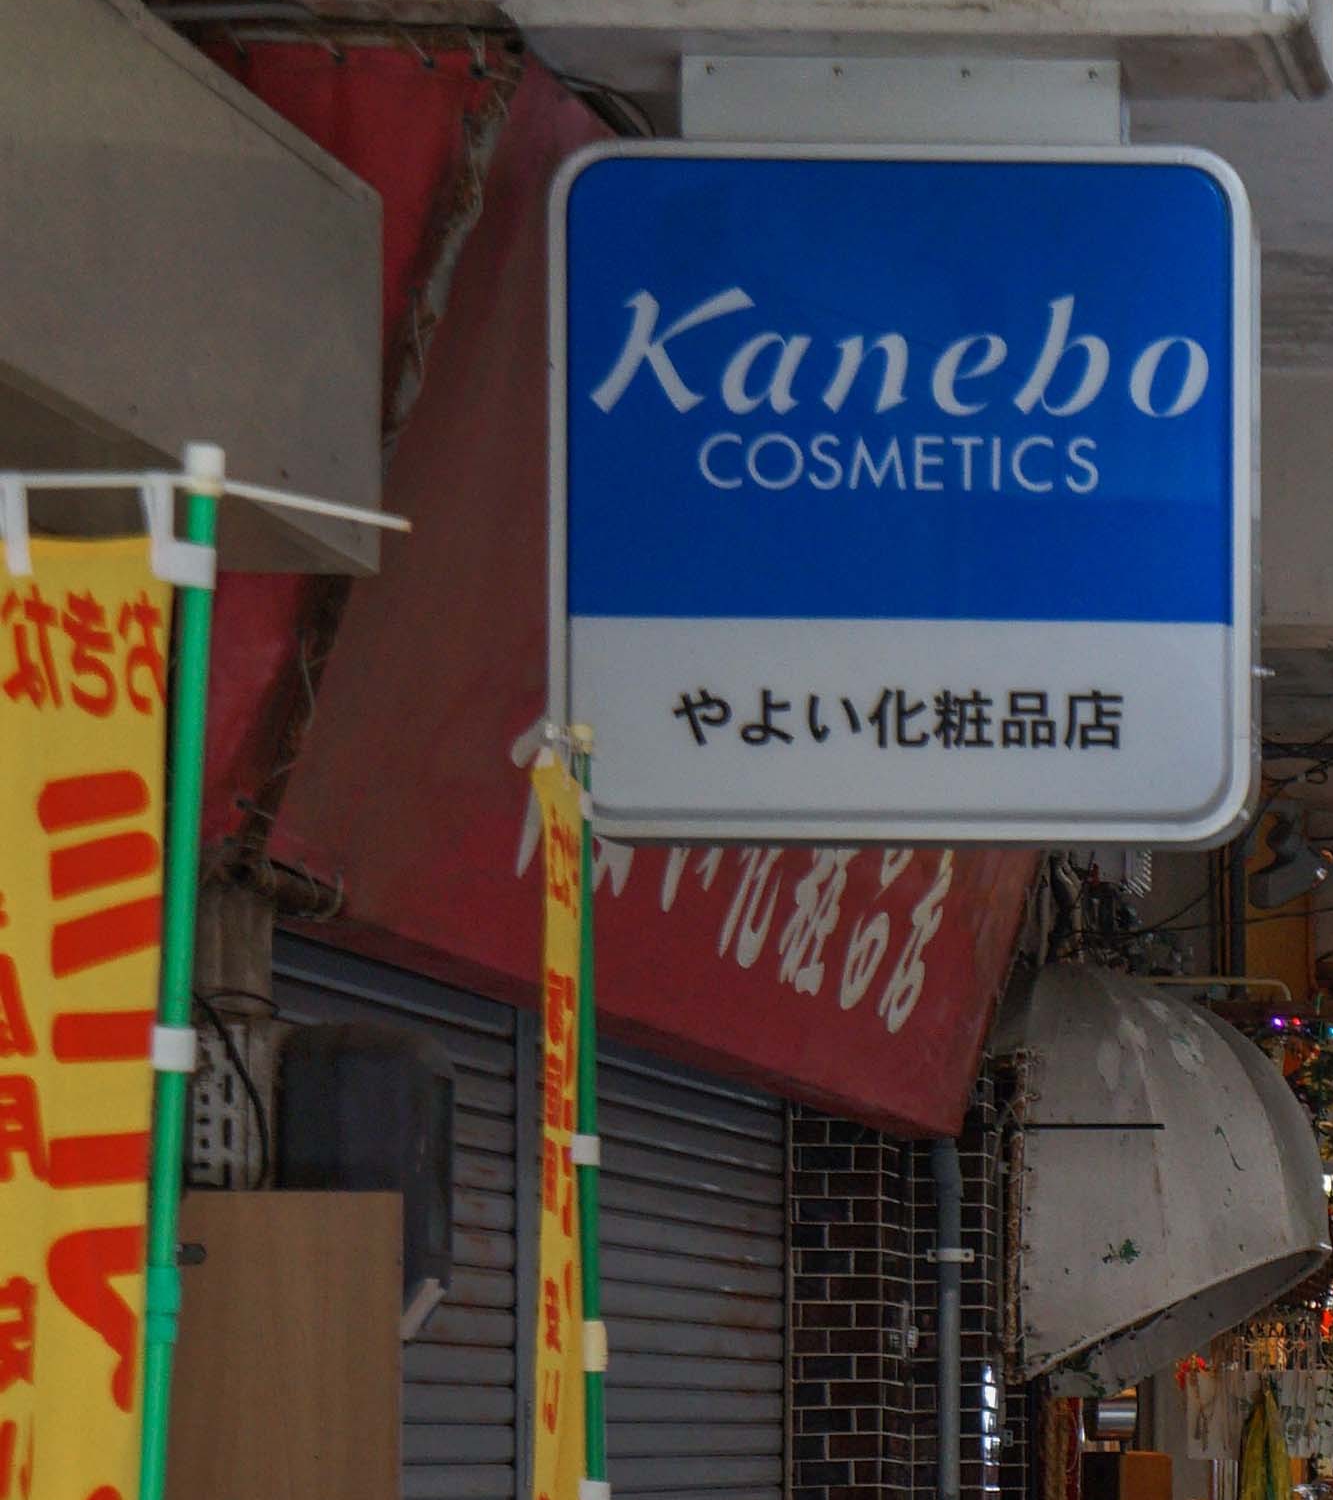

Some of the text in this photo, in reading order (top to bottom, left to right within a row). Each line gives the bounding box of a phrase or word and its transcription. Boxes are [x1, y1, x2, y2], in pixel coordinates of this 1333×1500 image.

[590, 287, 1210, 418] Kanebo
[698, 433, 1100, 493] COSMETICS
[673, 688, 1125, 750] やよい化粧品店
